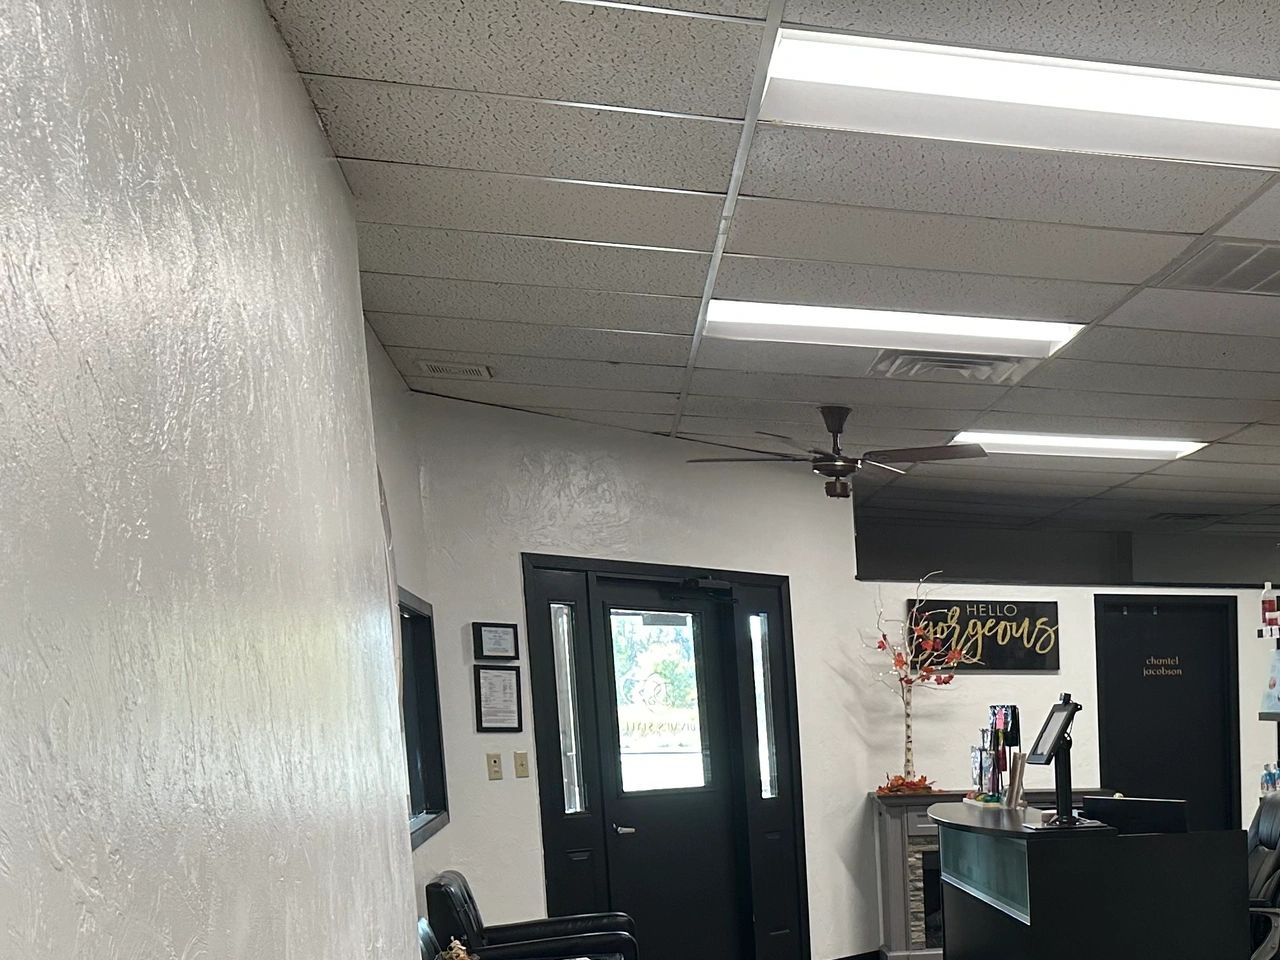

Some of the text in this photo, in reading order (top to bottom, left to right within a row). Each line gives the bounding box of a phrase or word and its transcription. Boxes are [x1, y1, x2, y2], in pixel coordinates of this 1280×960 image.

[966, 604, 1018, 617] HELLO
[1146, 656, 1179, 665] chantel
[1143, 666, 1182, 677] jacobson
